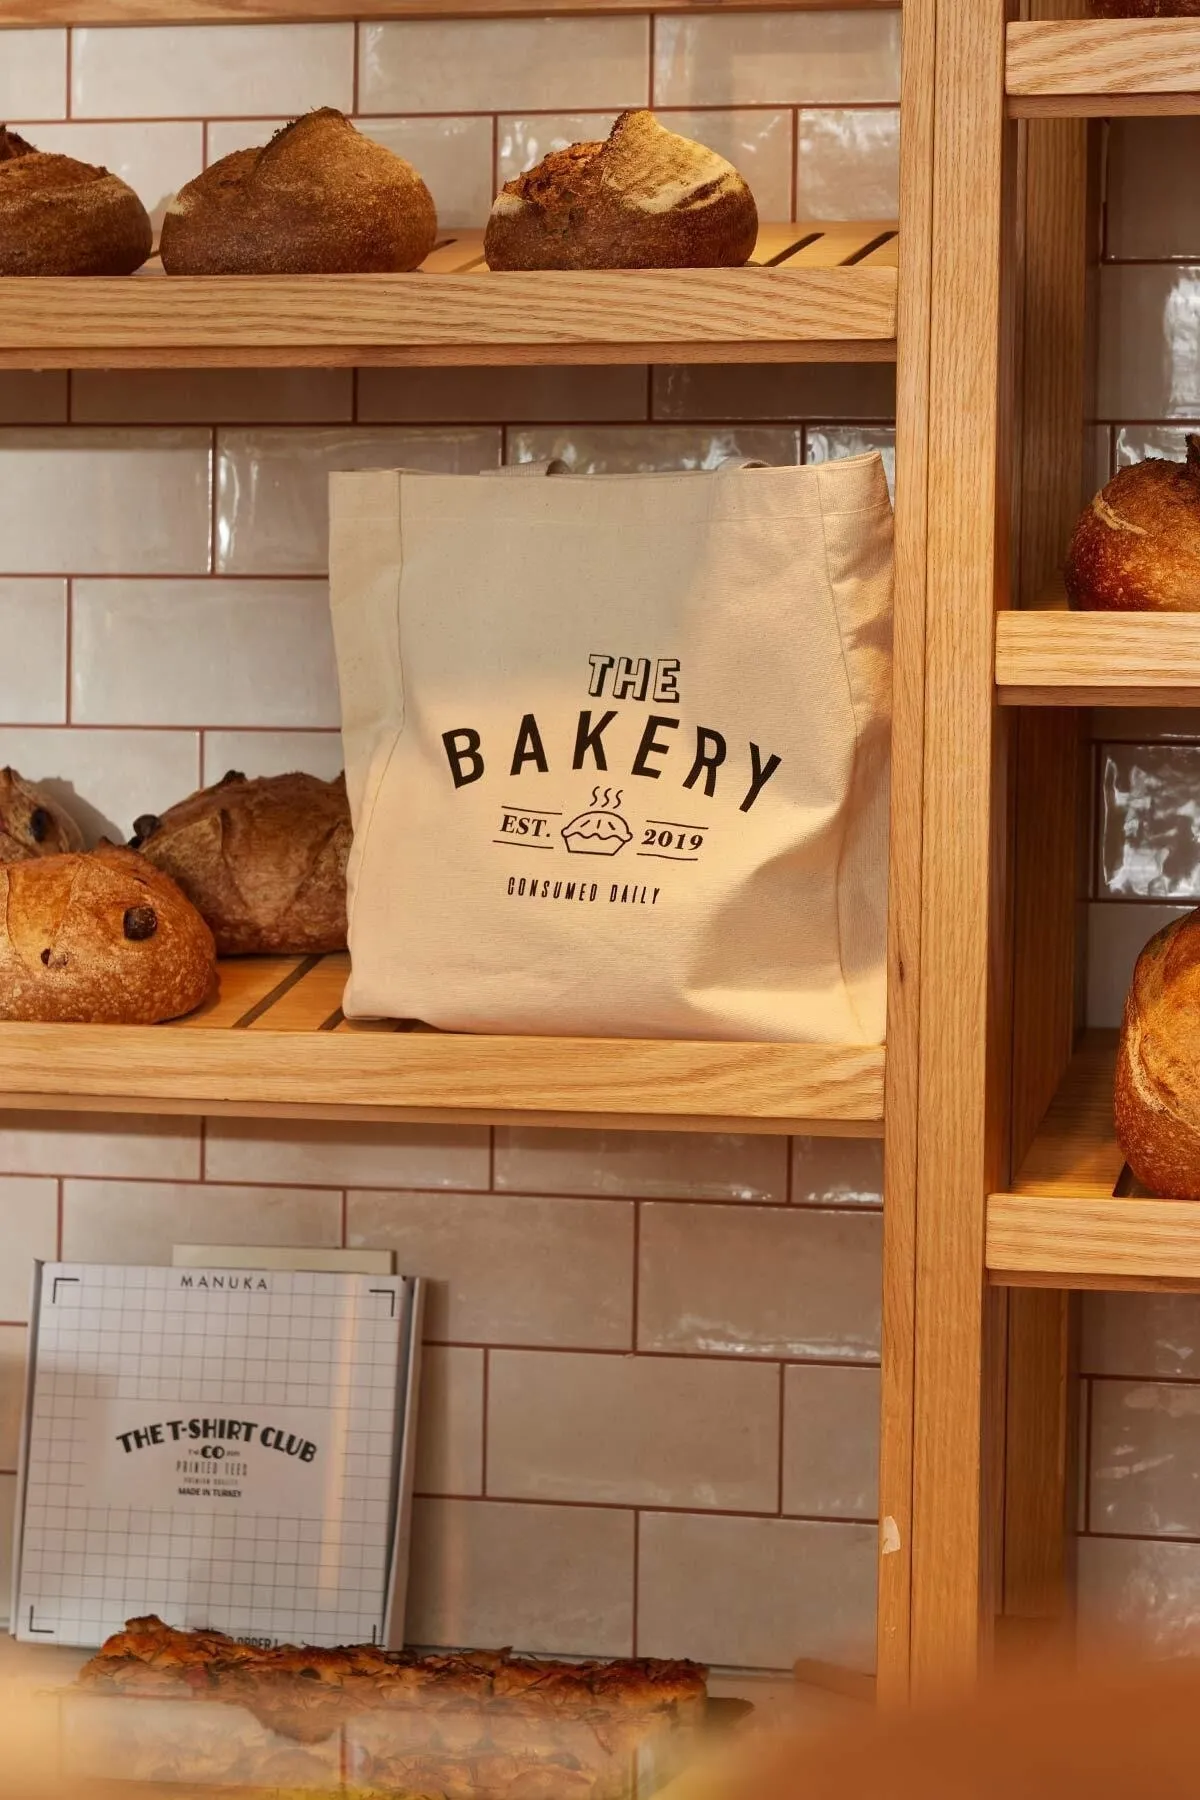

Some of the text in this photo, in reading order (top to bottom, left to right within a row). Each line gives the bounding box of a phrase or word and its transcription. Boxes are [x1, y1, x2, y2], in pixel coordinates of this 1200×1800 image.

[588, 653, 681, 704] THE
[441, 710, 782, 813] BAKERY
[498, 813, 704, 851] EST. 2019
[507, 876, 661, 905] CONSUMED DAILY
[180, 1275, 268, 1290] MANUKA
[116, 1418, 318, 1463] THE T-SHIRT CLUB
[201, 1445, 225, 1460] CO
[176, 1460, 248, 1477] PRINTED TEES
[178, 1487, 242, 1498] MADE IN TURKEY
